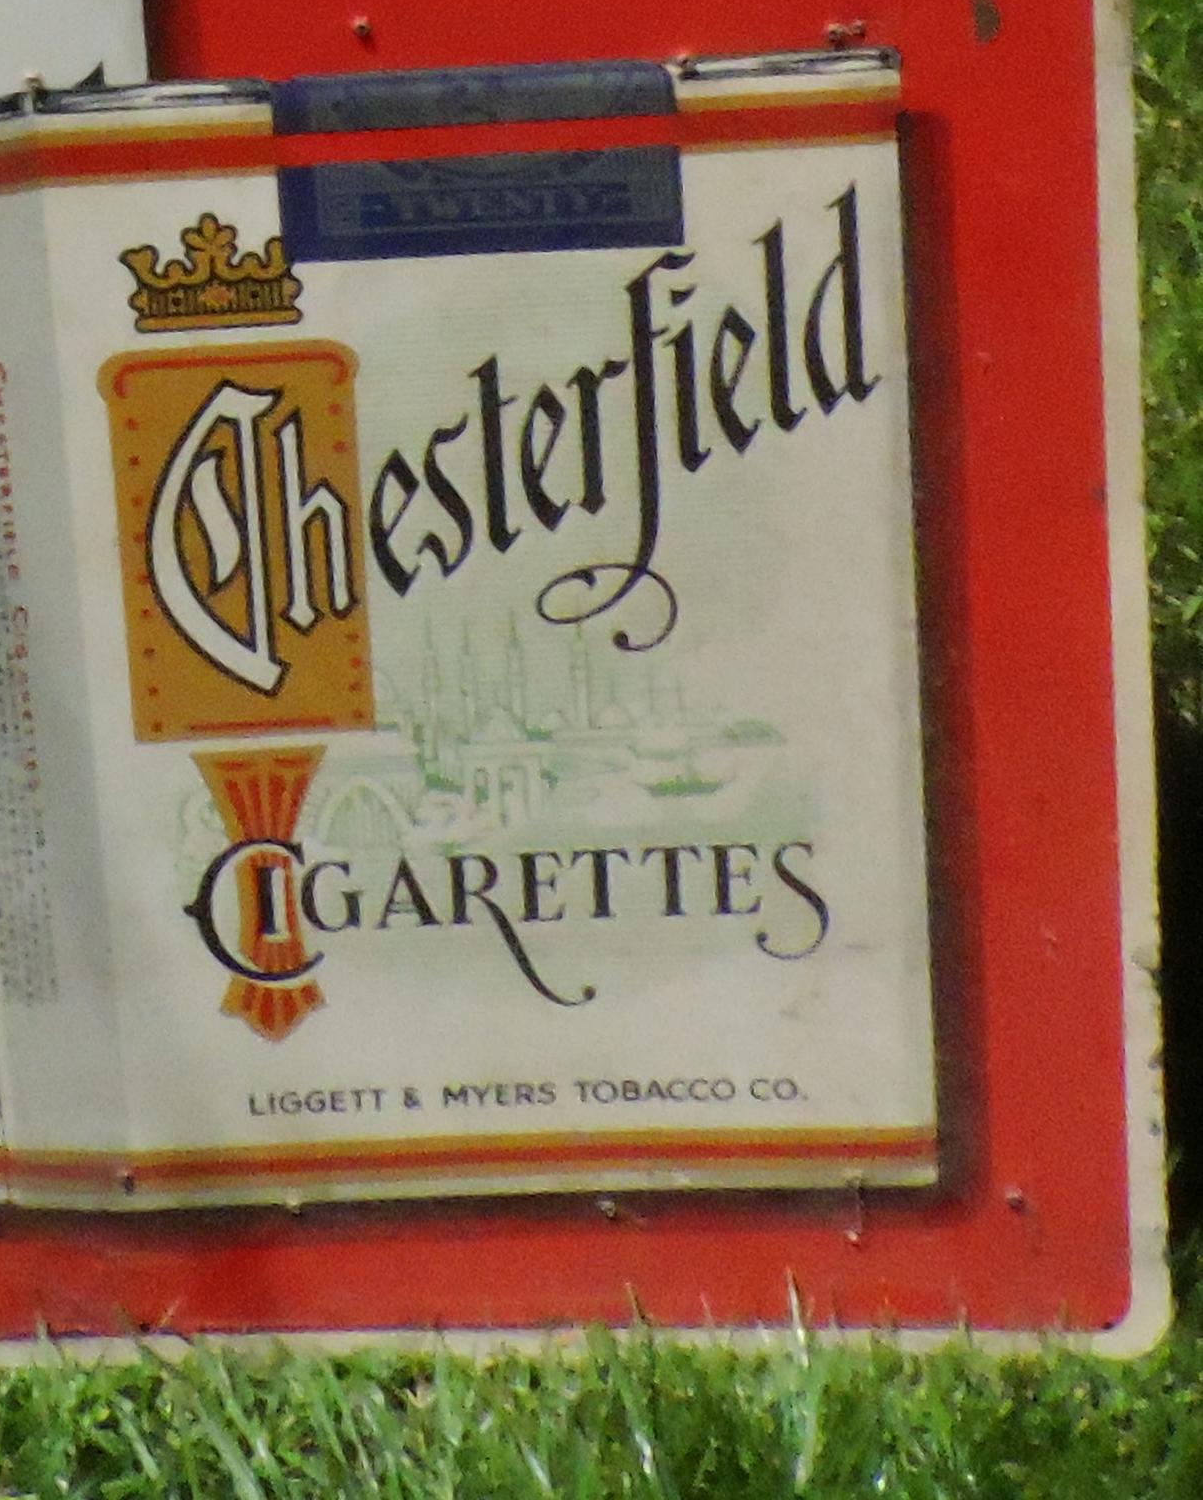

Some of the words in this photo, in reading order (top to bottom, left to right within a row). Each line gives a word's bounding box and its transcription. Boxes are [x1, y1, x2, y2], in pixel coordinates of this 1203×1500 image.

[146, 180, 882, 696] Chesterfield
[181, 838, 830, 1007] CIGARETTES
[249, 1088, 385, 1117] LIGGETT
[402, 1087, 422, 1111] &
[442, 1081, 557, 1108] MYERS
[574, 1078, 737, 1104] TOBACCO
[749, 1077, 810, 1103] CO.
